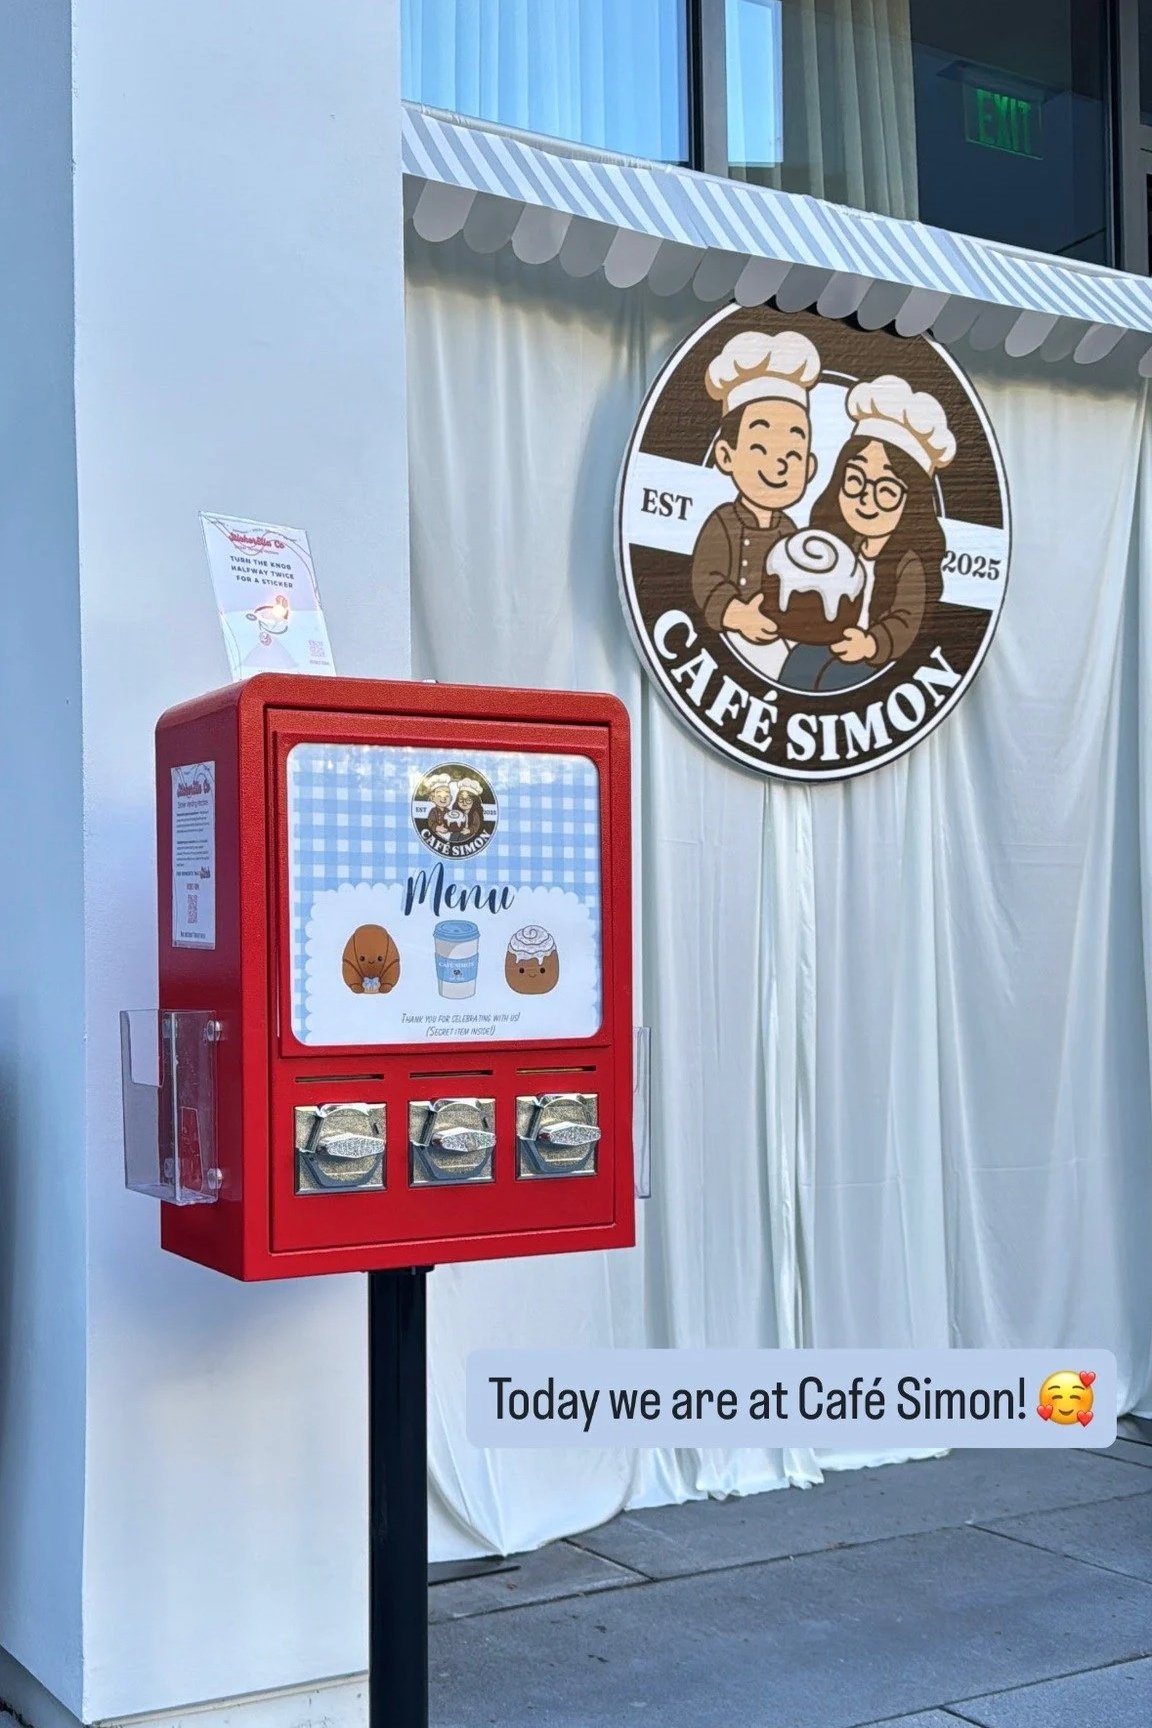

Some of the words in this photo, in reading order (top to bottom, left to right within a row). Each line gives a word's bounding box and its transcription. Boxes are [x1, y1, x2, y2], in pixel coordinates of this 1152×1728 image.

[976, 88, 1031, 154] EXIT
[641, 487, 693, 520] EST
[230, 556, 251, 564] TURN
[270, 562, 291, 570] KNOB
[231, 565, 268, 576] HALFWAY
[270, 571, 294, 579] TWICE
[942, 550, 1001, 580] 2025
[262, 579, 293, 588] STICKER
[652, 609, 778, 752] CAFÉ
[786, 645, 963, 762] SIMON
[421, 829, 451, 855] CAFÉ
[452, 830, 491, 855] SIMON
[403, 861, 515, 917] Menu
